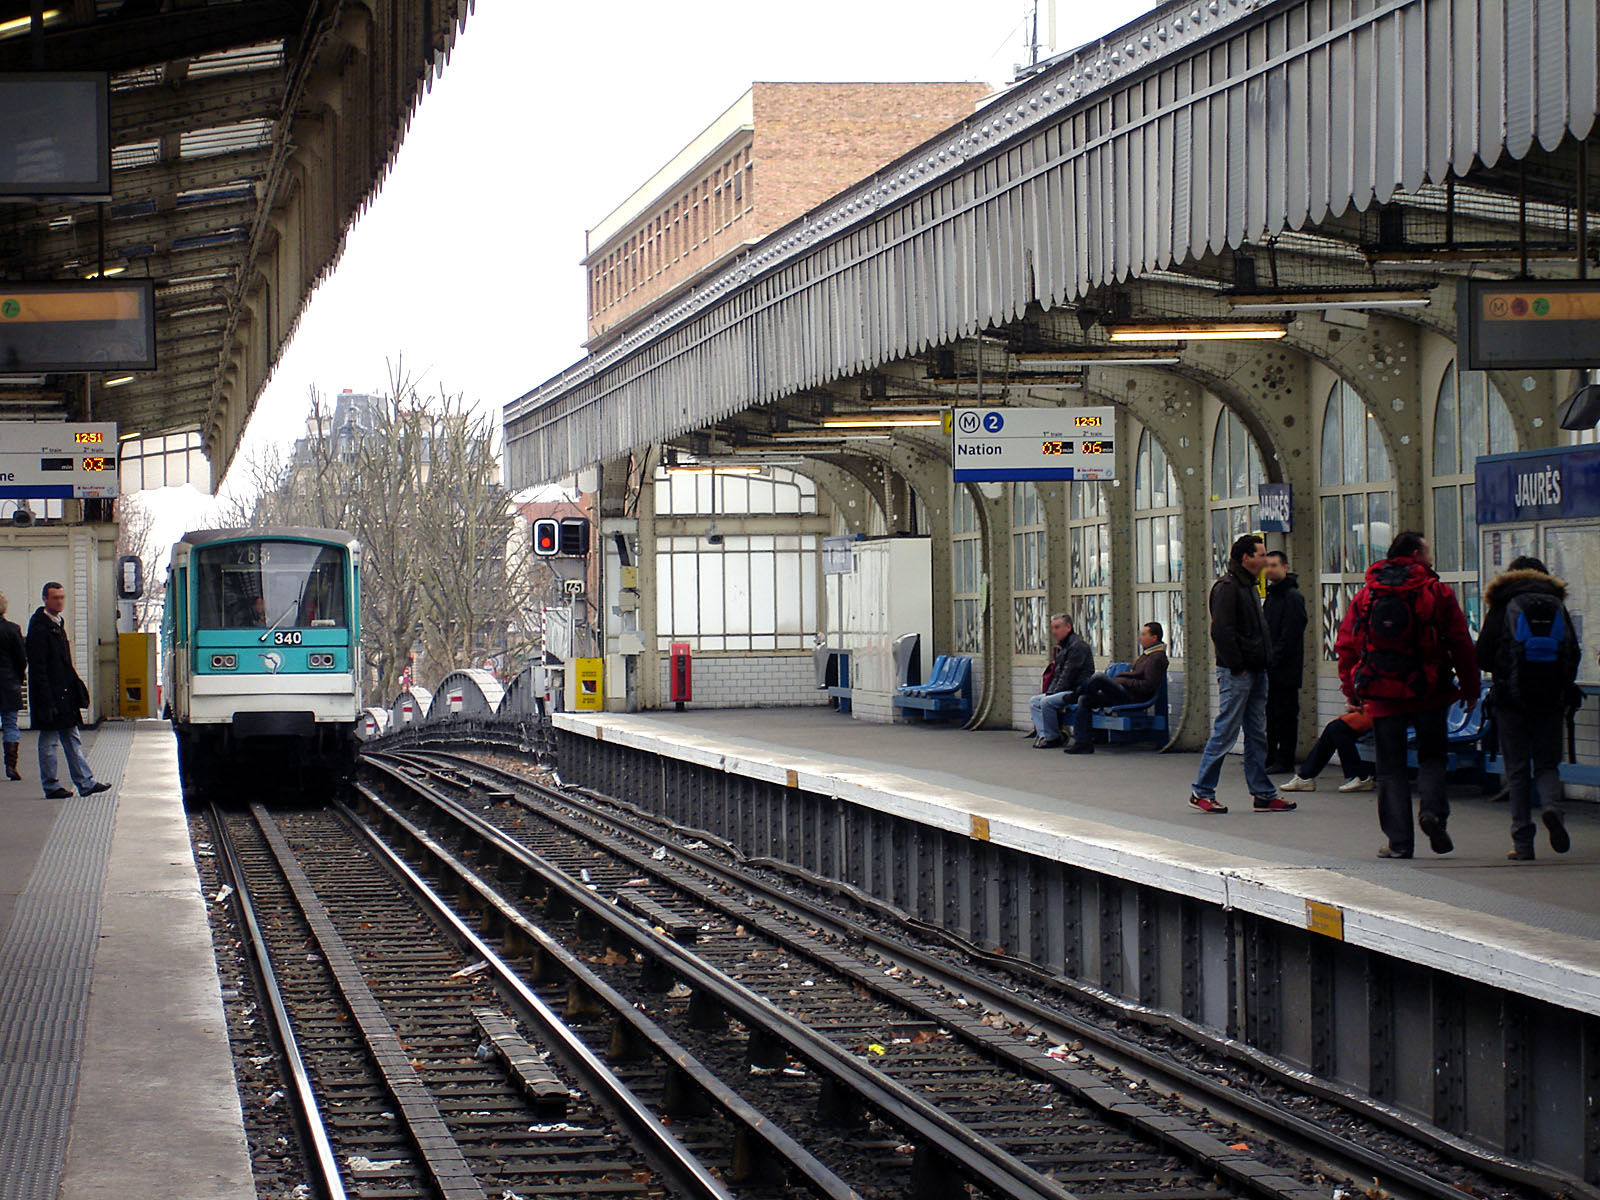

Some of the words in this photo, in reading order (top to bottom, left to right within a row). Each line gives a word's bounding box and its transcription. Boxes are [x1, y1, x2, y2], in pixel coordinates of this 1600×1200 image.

[1075, 417, 1101, 427] 12:51
[75, 432, 102, 443] 12:51
[958, 443, 1002, 456] Nation
[1042, 441, 1063, 455] 03
[1082, 441, 1103, 454] 06
[83, 457, 104, 472] 03
[1515, 465, 1561, 507] JAURÈS
[274, 632, 302, 645] 340
